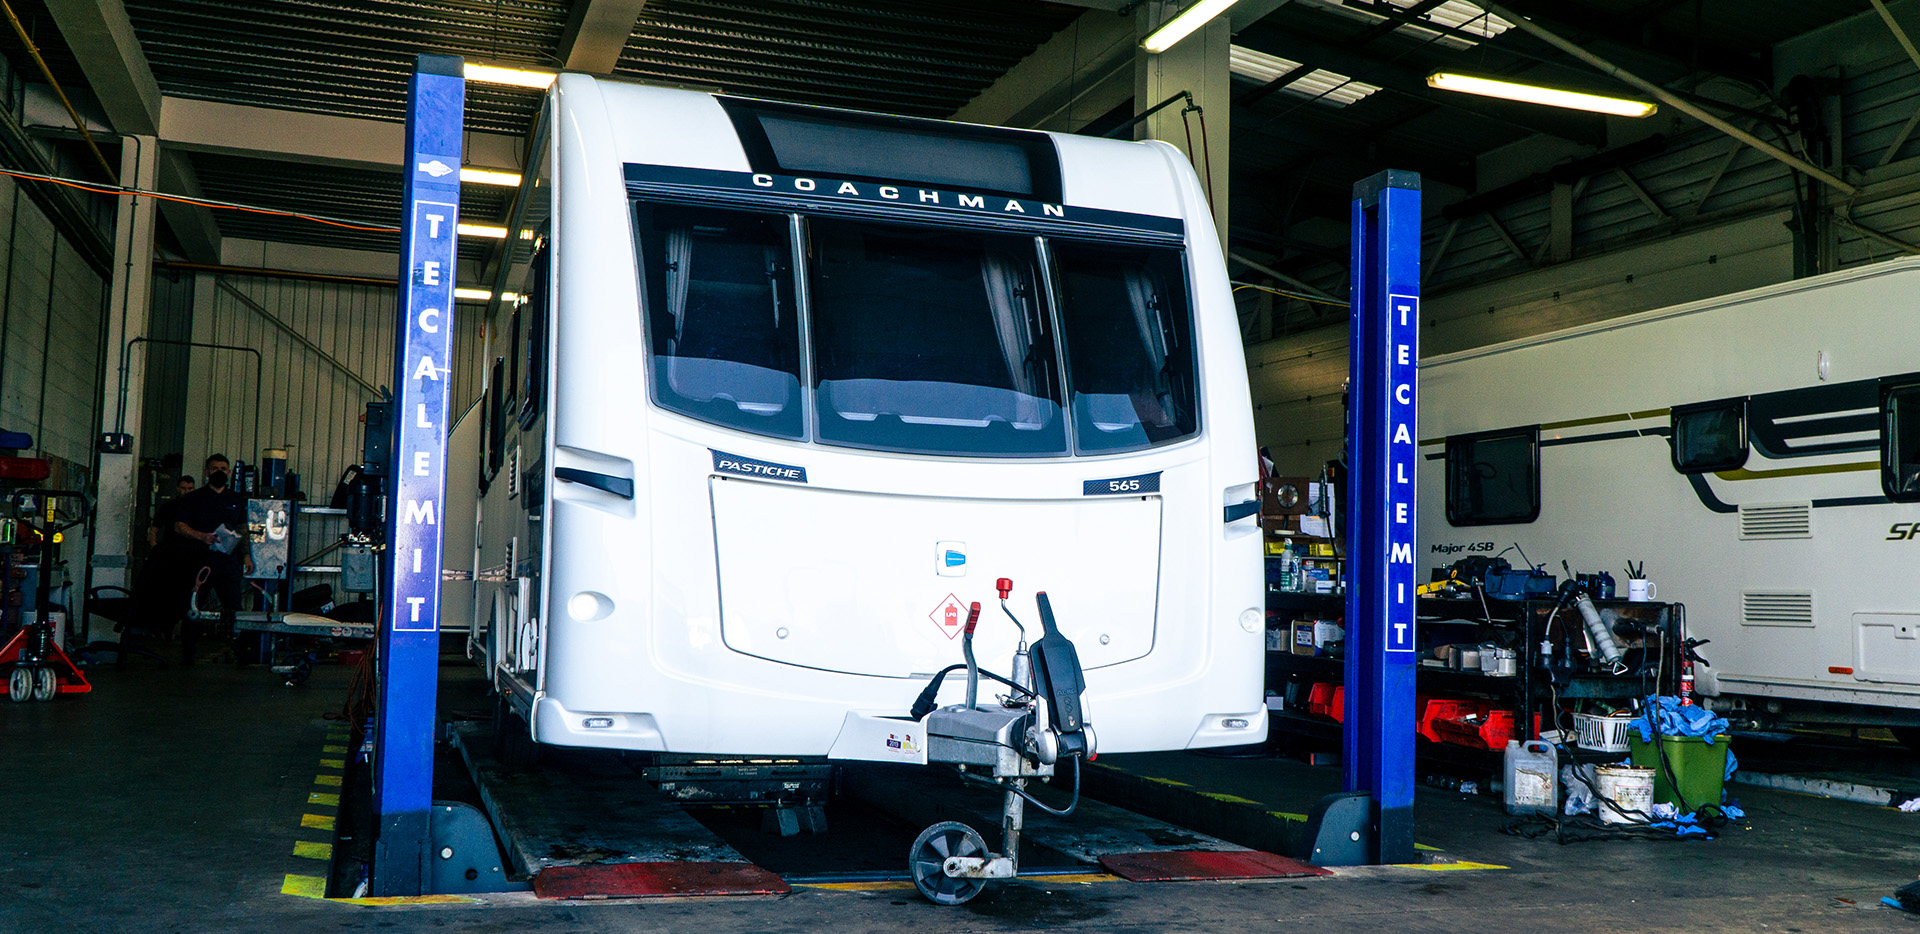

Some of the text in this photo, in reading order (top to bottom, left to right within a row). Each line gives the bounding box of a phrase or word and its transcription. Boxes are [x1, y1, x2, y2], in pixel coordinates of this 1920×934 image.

[752, 173, 1066, 218] COACHMAN
[404, 213, 445, 623] TECALEMIT
[718, 460, 801, 479] PASTICHE
[1390, 305, 1413, 644] TECALEMIT
[1109, 480, 1140, 493] 565
[1431, 542, 1495, 555] Major 4SB
